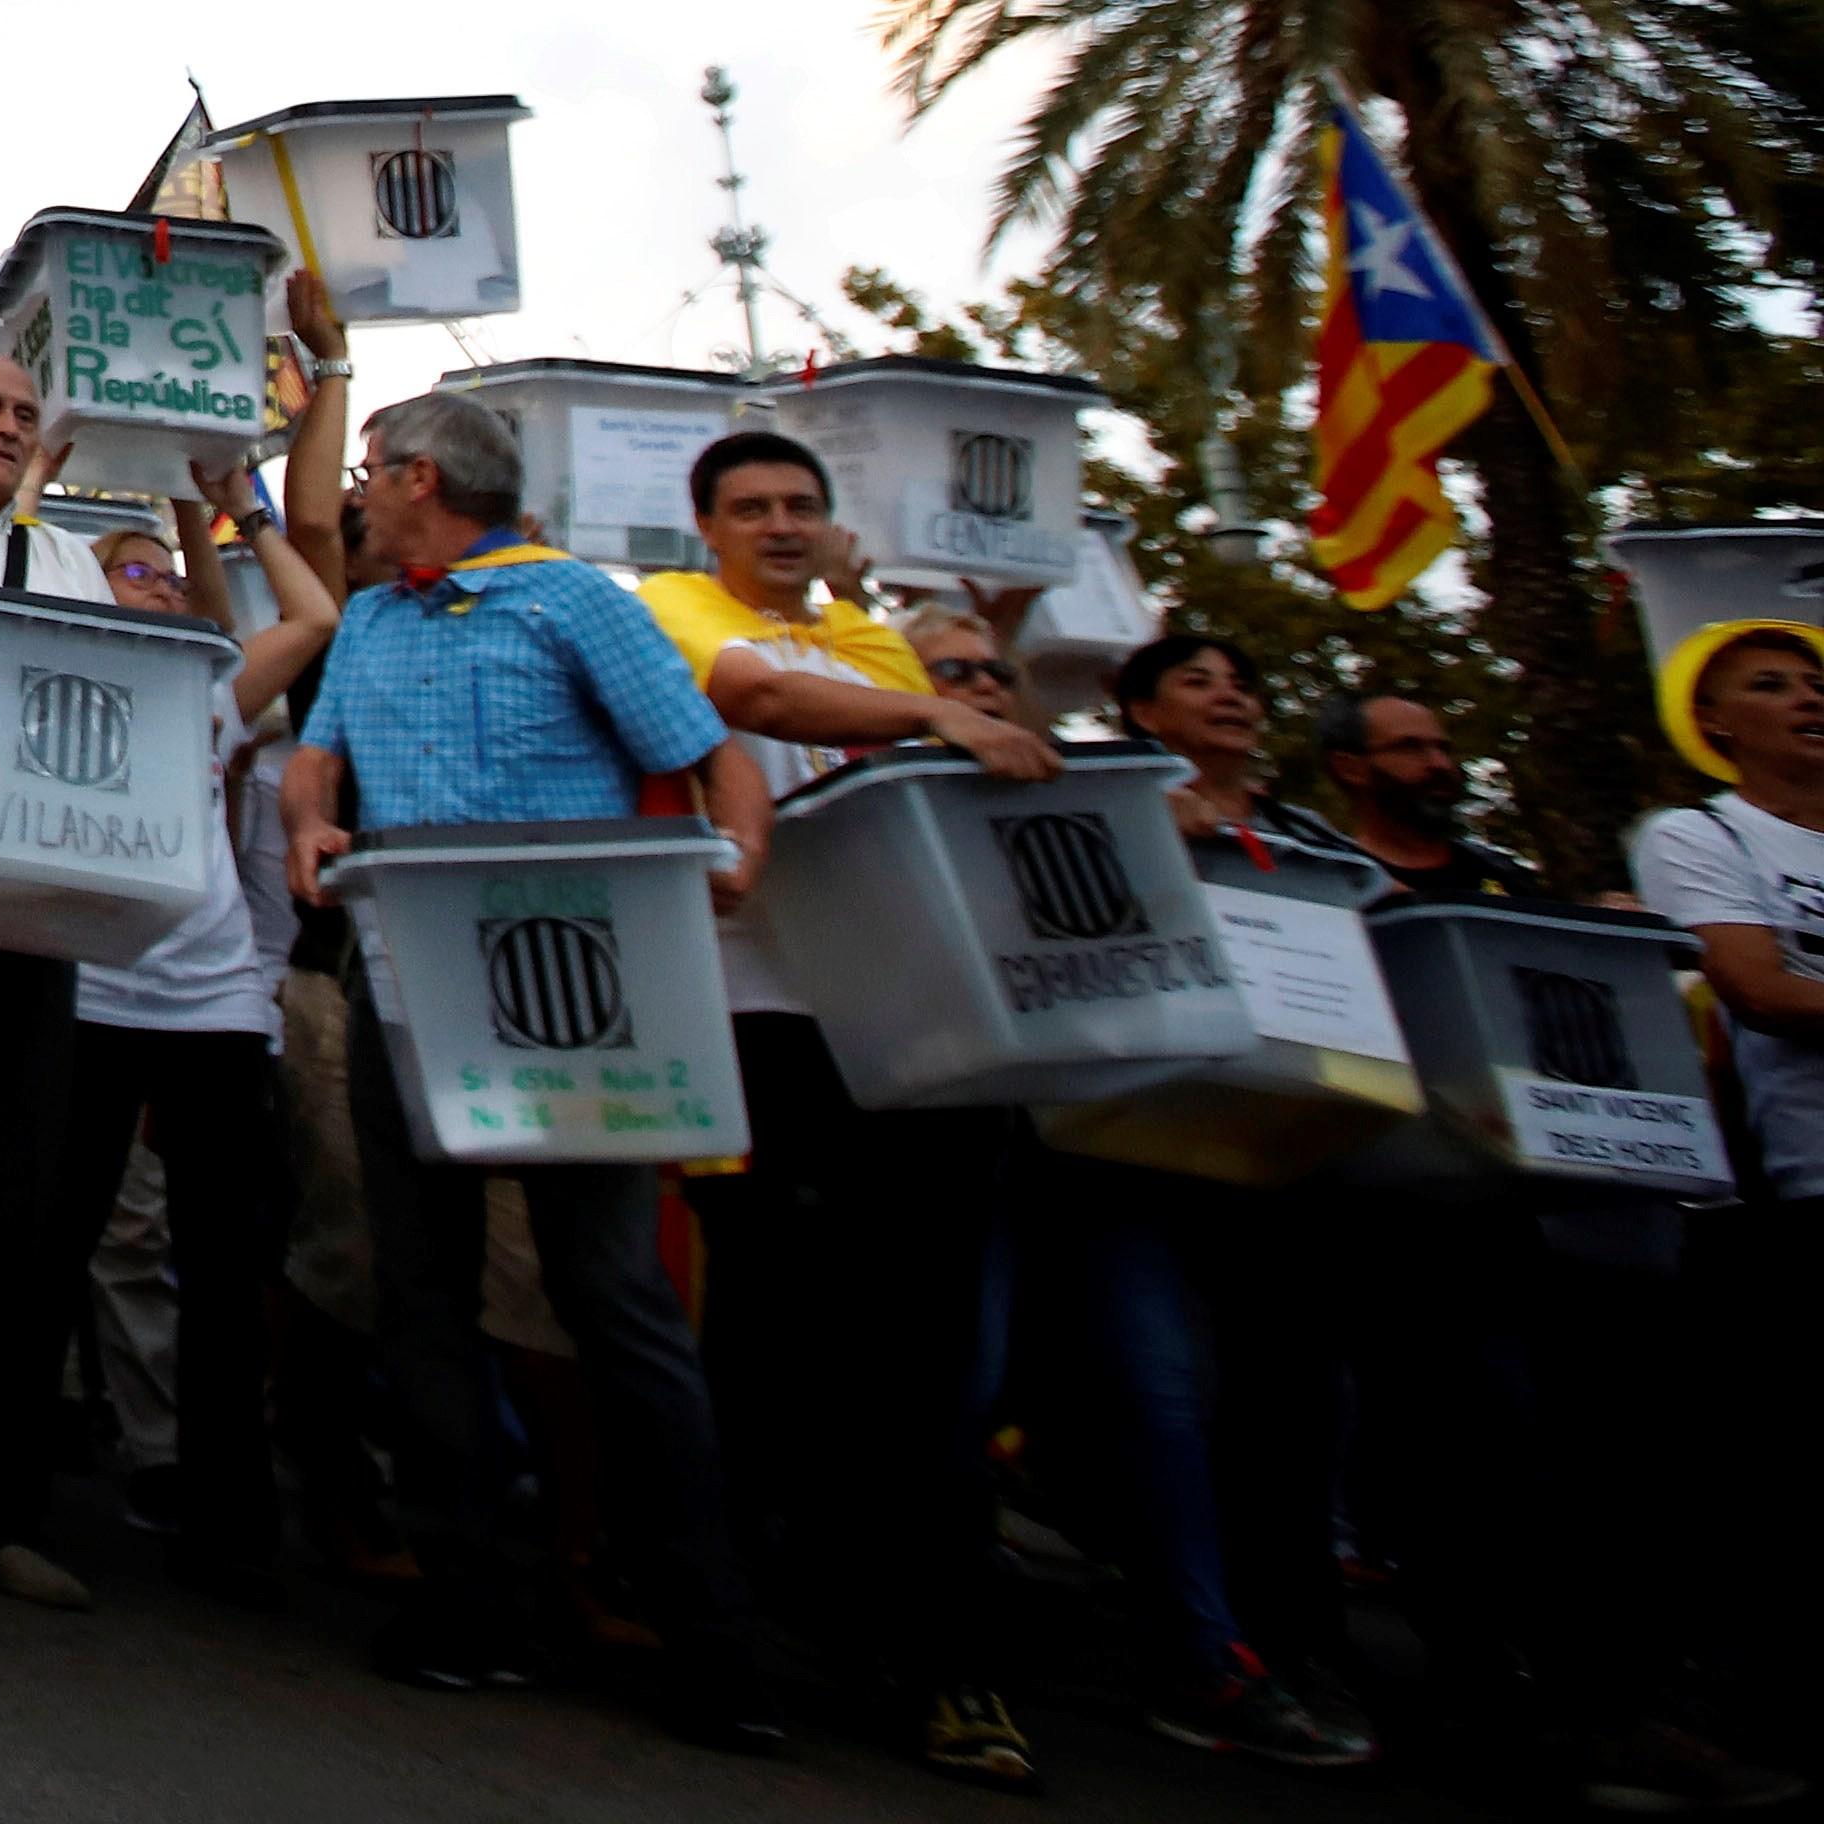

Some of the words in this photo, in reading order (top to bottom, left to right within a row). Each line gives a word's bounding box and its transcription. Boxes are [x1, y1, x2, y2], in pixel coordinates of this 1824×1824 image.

[67, 314, 92, 341] a
[99, 309, 130, 348] la
[170, 300, 243, 370] SÍ
[67, 345, 256, 421] República
[1527, 1085, 1599, 1115] SANT
[1548, 1130, 1612, 1160] DELS
[1620, 1139, 1701, 1170] HORTS
